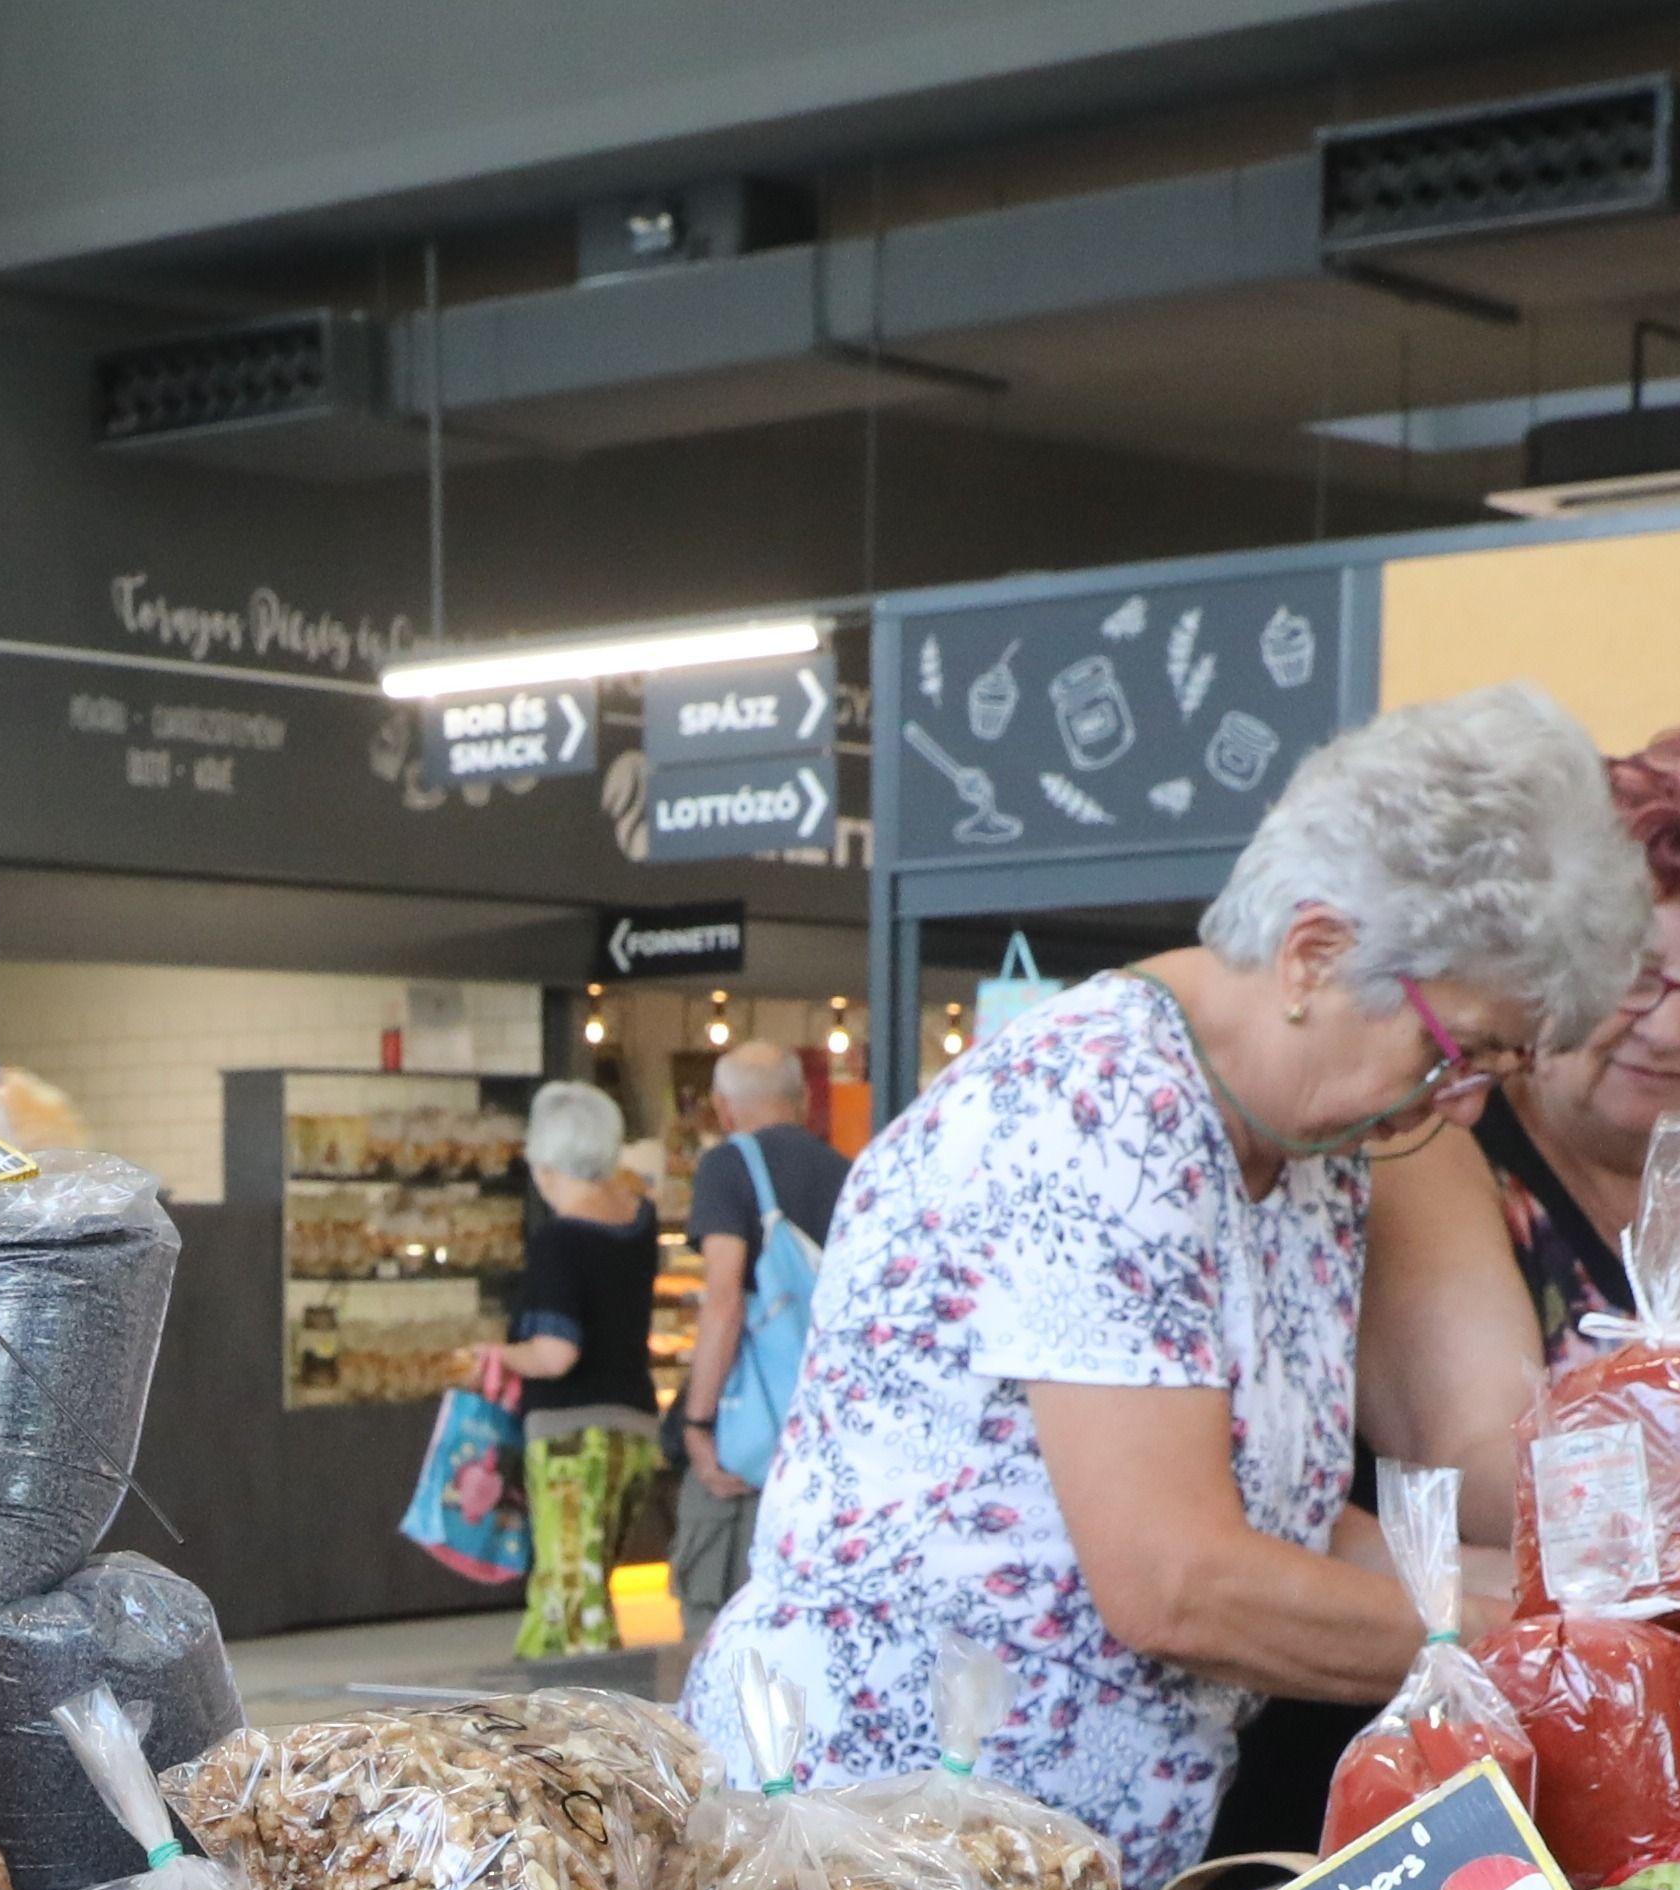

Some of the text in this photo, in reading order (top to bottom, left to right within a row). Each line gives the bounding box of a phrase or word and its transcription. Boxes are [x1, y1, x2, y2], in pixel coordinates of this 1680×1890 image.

[444, 692, 547, 740] BOR ÉS
[677, 692, 779, 736] SPÁJZ
[448, 733, 548, 775] SNACK
[656, 782, 800, 833] LOTTÓZÓ
[626, 922, 740, 957] FORNETTI
